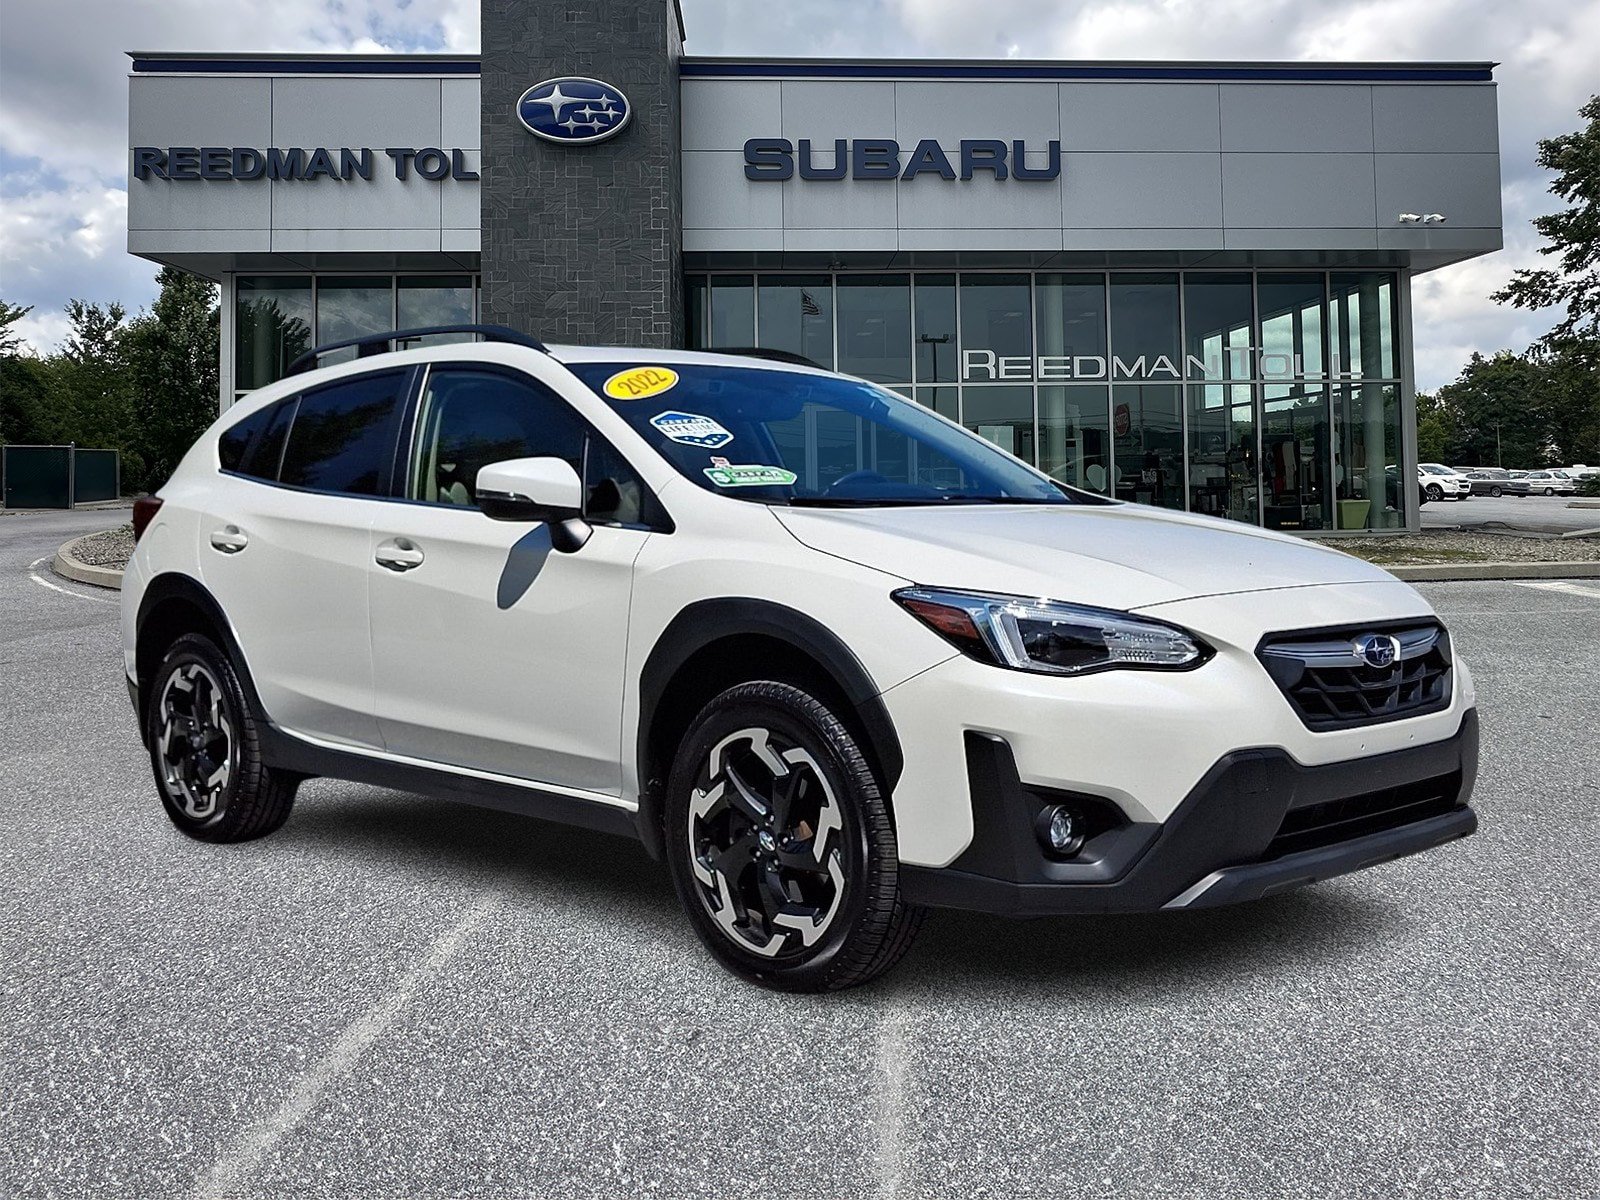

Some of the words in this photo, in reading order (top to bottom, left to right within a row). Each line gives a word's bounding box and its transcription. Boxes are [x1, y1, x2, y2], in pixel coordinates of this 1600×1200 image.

[133, 147, 373, 181] REEDMAN
[743, 138, 1061, 181] SUBARU
[617, 369, 668, 395] 2022
